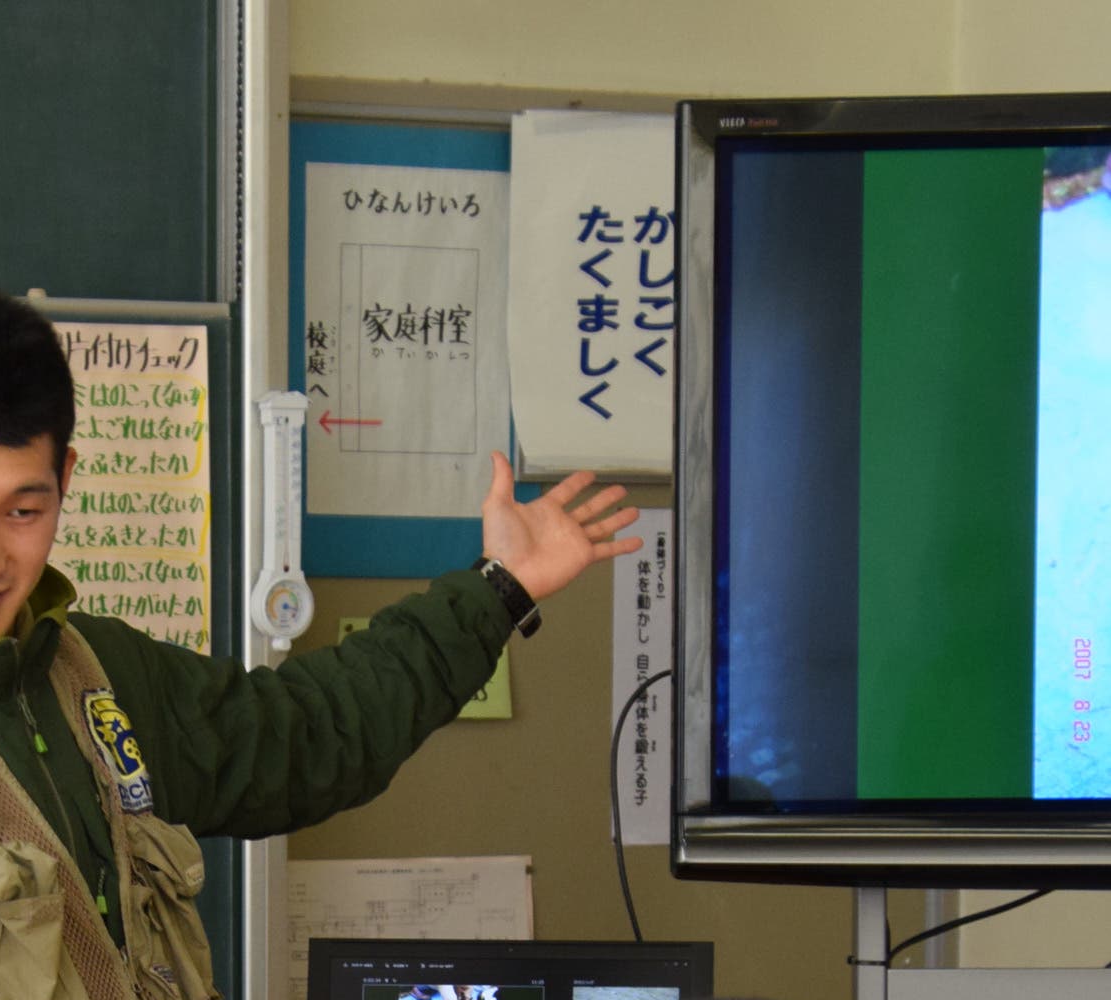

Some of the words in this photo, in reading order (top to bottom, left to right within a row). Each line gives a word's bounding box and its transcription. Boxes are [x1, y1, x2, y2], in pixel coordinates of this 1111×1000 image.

[343, 188, 481, 217] ひなんけいろ
[577, 205, 624, 420] たくましく
[634, 206, 675, 377] かしこく
[362, 302, 472, 346] 家庭科室
[305, 320, 330, 398] 校庭へ
[53, 523, 198, 549] 気をふきとったか
[1074, 638, 1092, 680] 2007
[1073, 720, 1091, 742] 23
